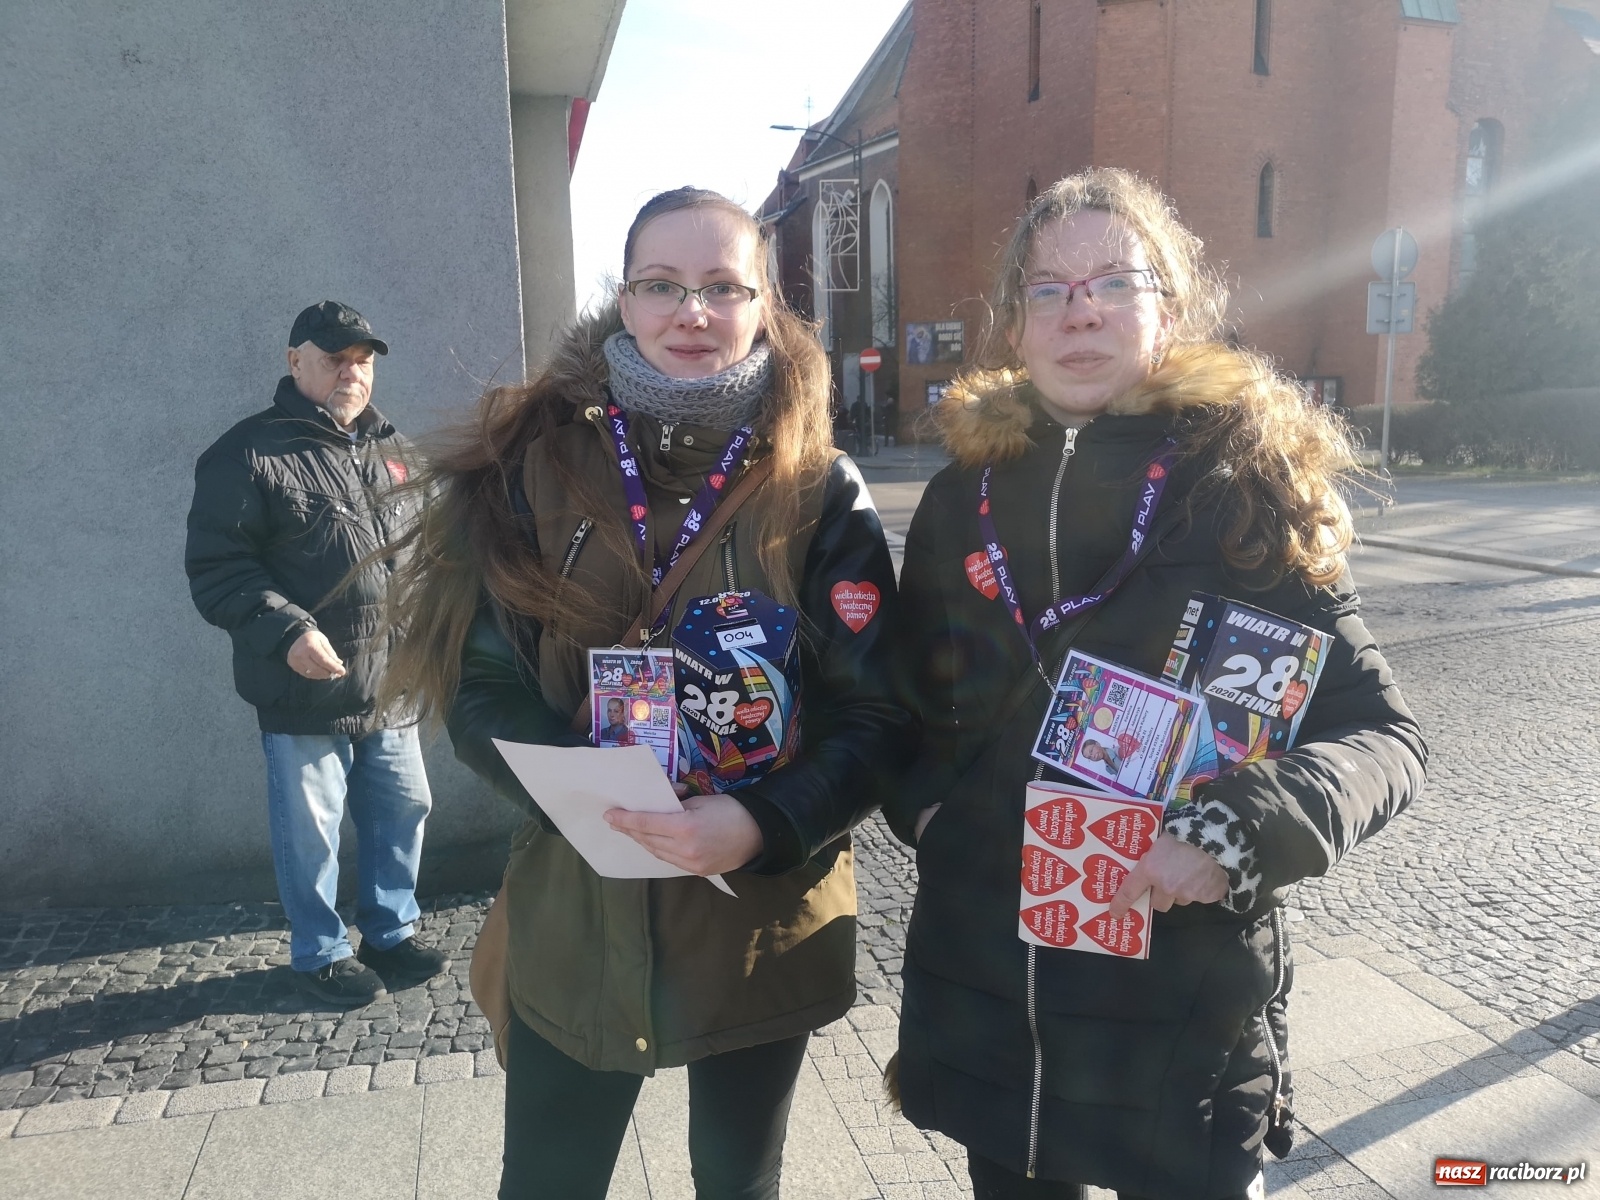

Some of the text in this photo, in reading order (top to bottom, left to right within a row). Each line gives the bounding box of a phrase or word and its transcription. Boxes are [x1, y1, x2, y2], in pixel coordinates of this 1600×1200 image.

[621, 459, 632, 476] 28
[721, 436, 743, 472] PLAY
[688, 510, 701, 531] 28
[1132, 528, 1141, 555] 28
[1138, 483, 1155, 525] PLAY
[989, 543, 1016, 604] 28 PLAY
[835, 589, 853, 599] wielka
[847, 612, 868, 622] pomocy
[1040, 595, 1101, 628] 28 PLAY
[724, 631, 753, 642] 004
[1226, 611, 1308, 647] WIATR W
[602, 668, 623, 683] 28
[675, 648, 733, 685] WIATR W
[1206, 654, 1299, 701] 28
[680, 684, 739, 725] 28
[1209, 686, 1235, 698] 2020
[1236, 692, 1281, 717] FINAŁ
[682, 705, 738, 735] 2020 FINAŁ
[1056, 724, 1070, 754] 28
